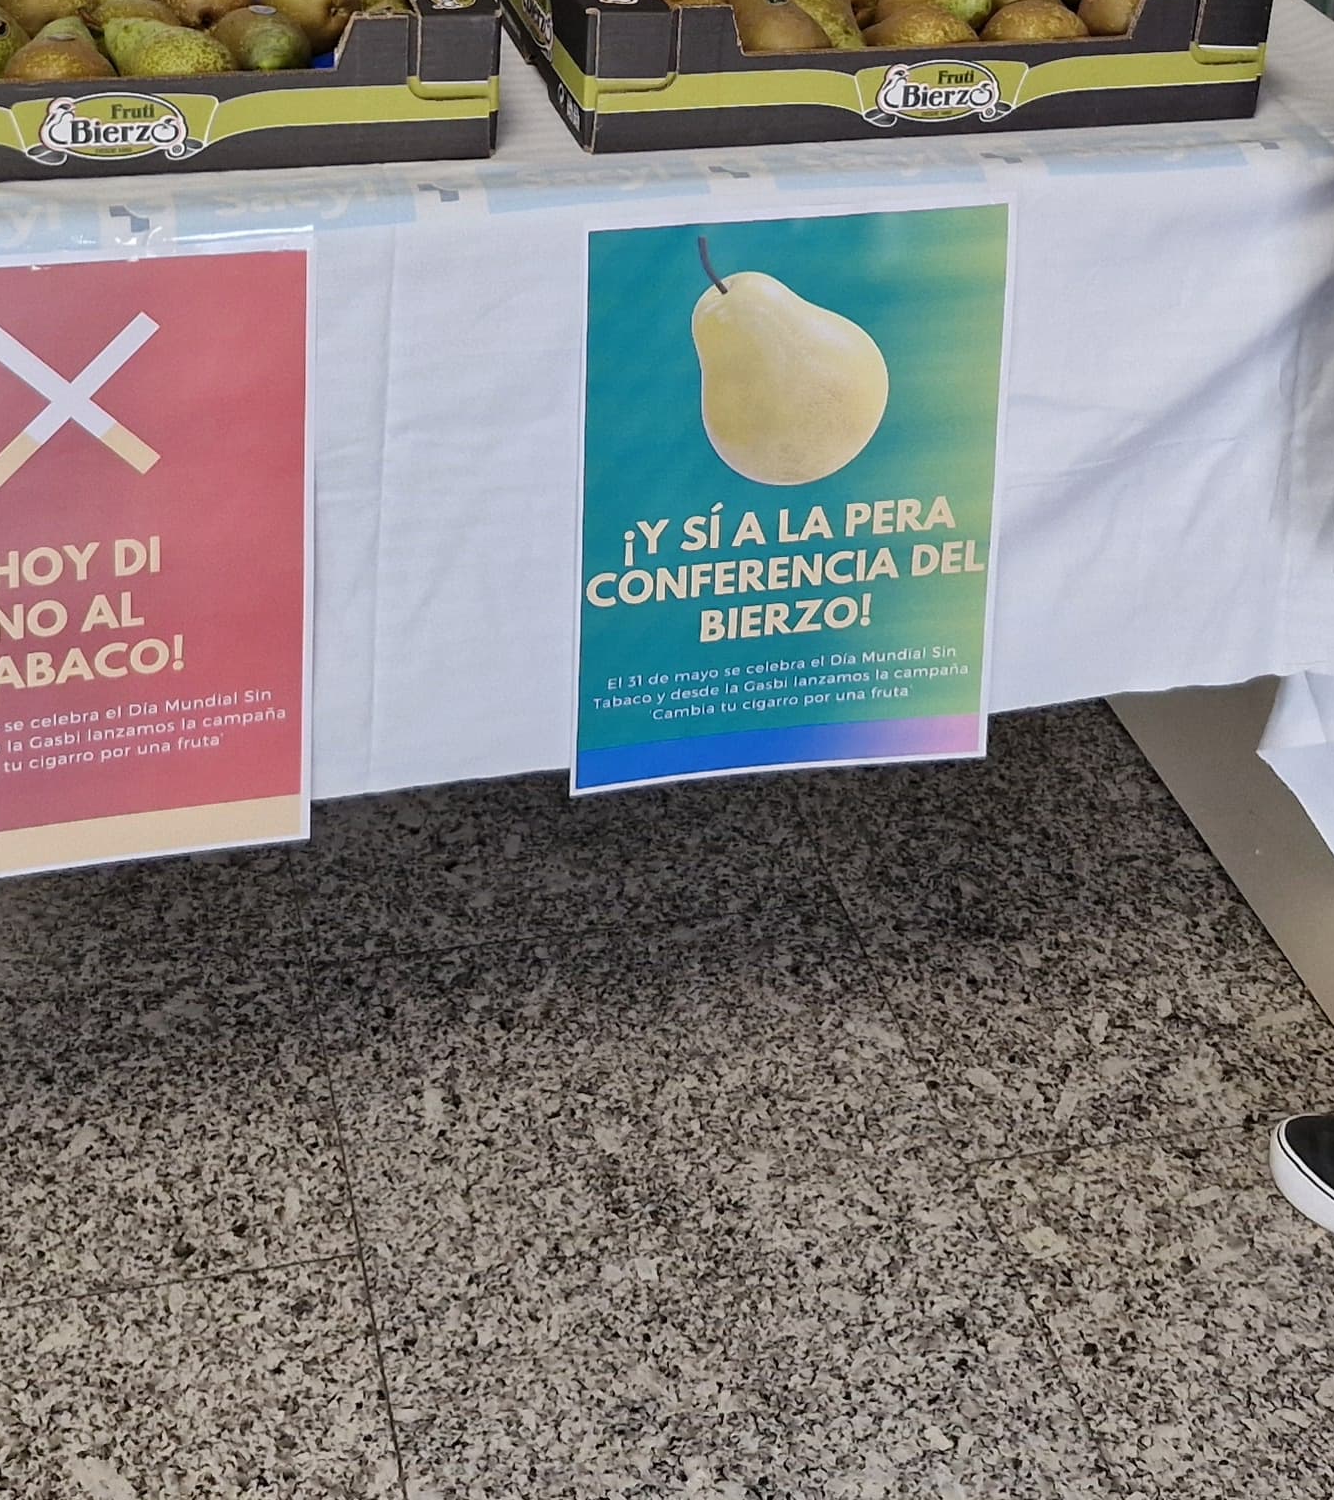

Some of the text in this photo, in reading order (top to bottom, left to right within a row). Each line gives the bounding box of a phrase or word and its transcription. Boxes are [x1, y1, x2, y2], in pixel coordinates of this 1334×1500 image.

[938, 70, 975, 84] Fruti
[111, 104, 155, 120] Fruti
[623, 495, 955, 567] ¡Y SÍ A LA PERA
[114, 536, 161, 579] DI
[585, 542, 984, 608] CONFERENCIA DEL
[82, 592, 144, 631] AL
[698, 593, 872, 643] BIERZO!
[593, 663, 969, 709] Tabaco y desde la Gasbi lanzamos la campaña
[608, 645, 956, 690] El 31 de mayo se celebra el Día Mundial Sin
[5, 719, 24, 733] se
[30, 711, 99, 728] celebra
[106, 706, 122, 720] el
[129, 702, 158, 717] Día
[166, 691, 238, 712] Mundial
[244, 689, 272, 703] Sin
[721, 701, 736, 713] tu
[742, 695, 798, 711] cigarro
[804, 692, 831, 707] por
[836, 690, 865, 701] una
[8, 739, 23, 753] la
[29, 732, 80, 749] Gasbi
[87, 720, 175, 742] lanzamos
[181, 717, 196, 730] la
[203, 707, 287, 727] campaña
[4, 760, 22, 773] tu
[29, 750, 93, 770] cigarro
[100, 746, 130, 763] por
[137, 742, 171, 755] una
